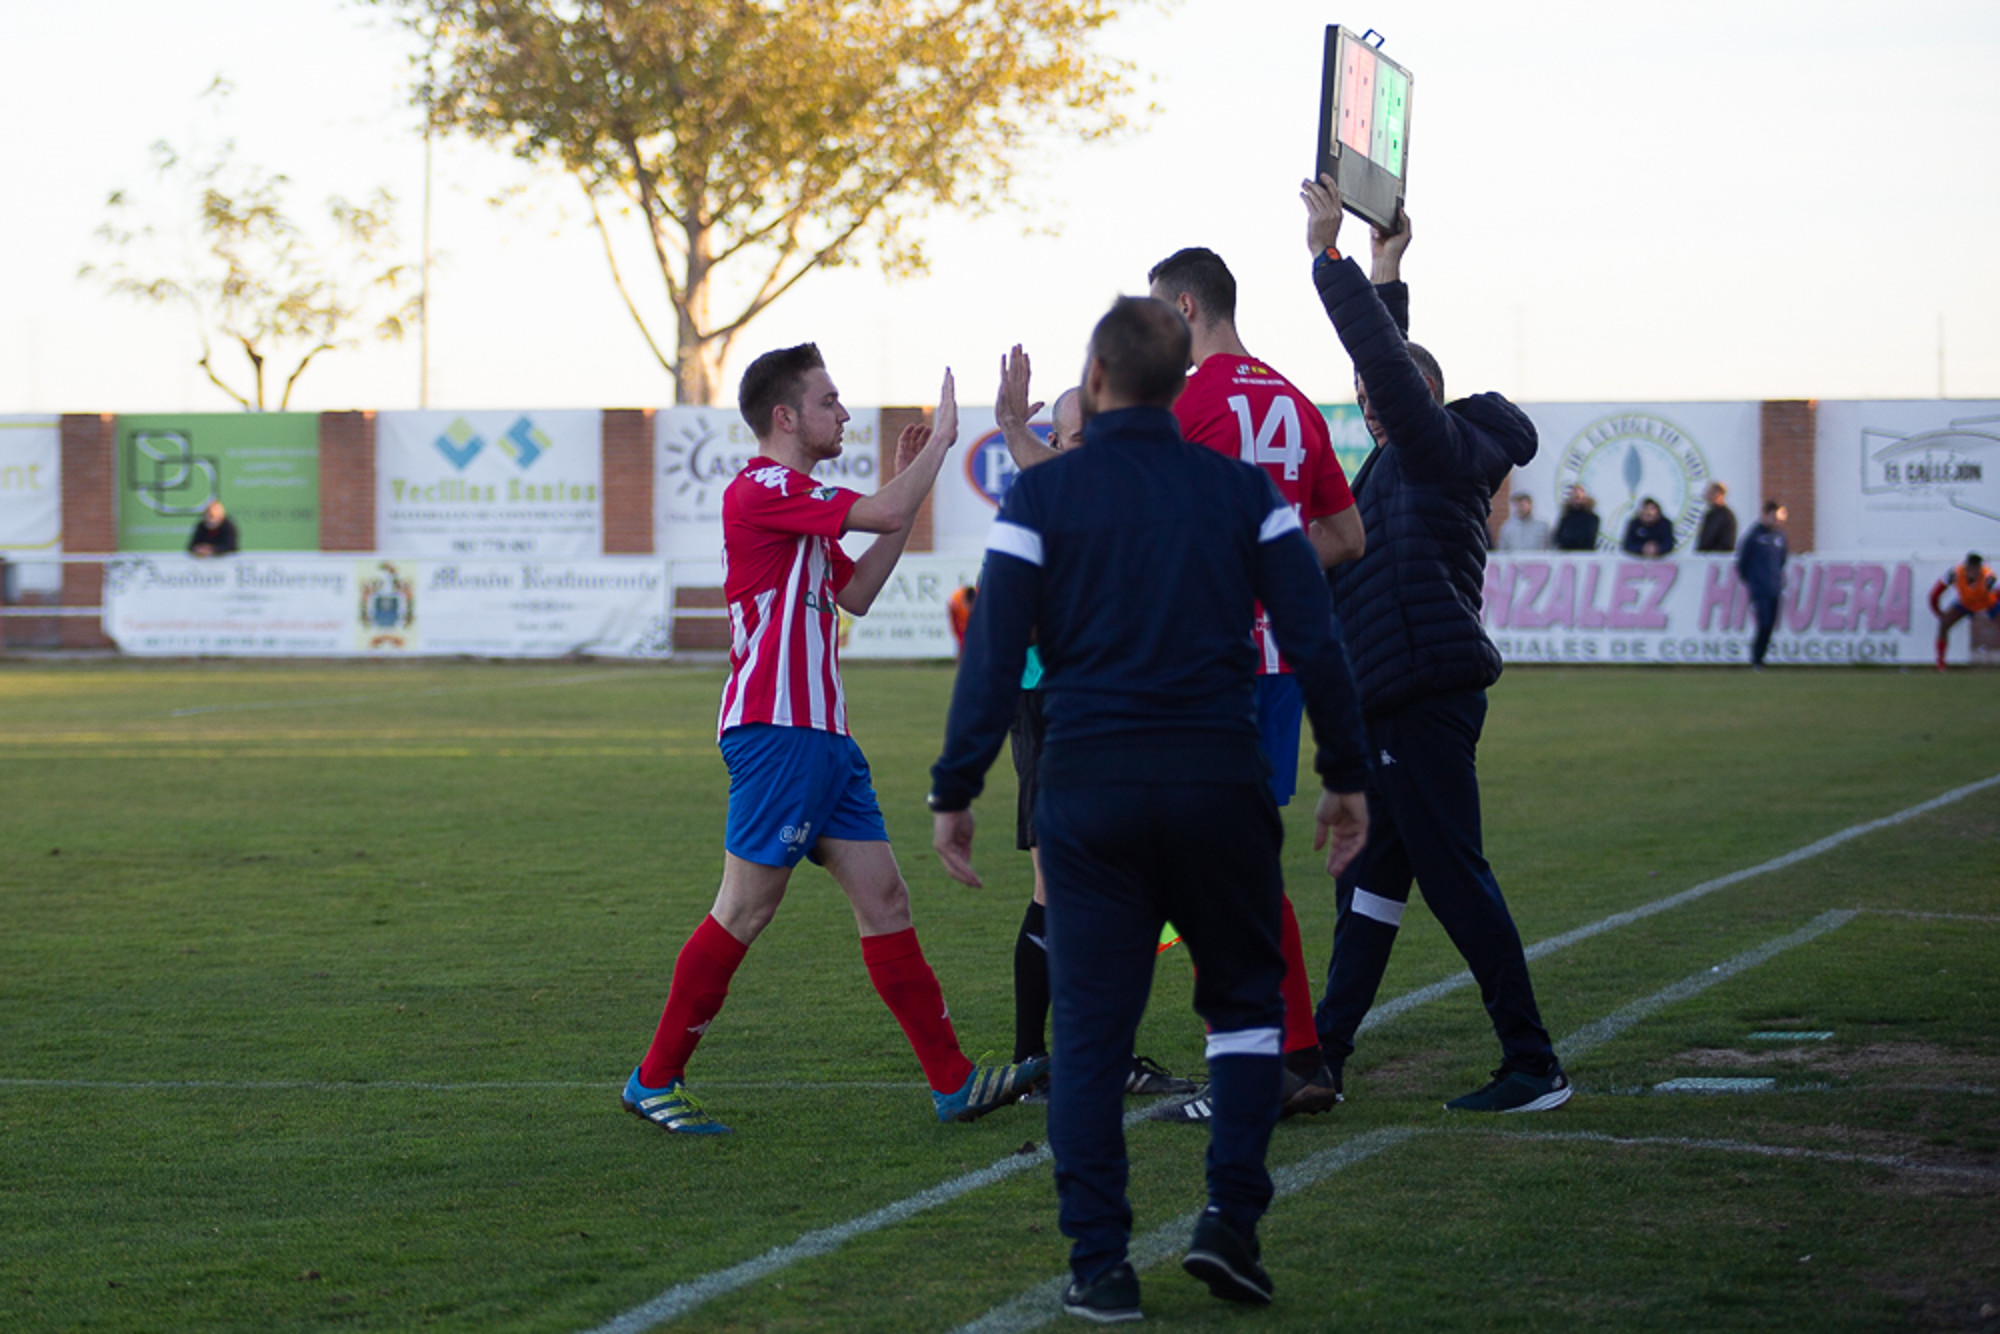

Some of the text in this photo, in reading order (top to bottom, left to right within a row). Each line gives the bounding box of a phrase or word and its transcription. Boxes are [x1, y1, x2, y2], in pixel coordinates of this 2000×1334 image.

[1227, 394, 1306, 481] 14
[0, 463, 42, 491] nt
[508, 478, 597, 502] Santos
[877, 573, 940, 604] AR
[1481, 562, 1911, 632] NZALEZ HIUERA
[1497, 638, 1598, 658] RIALES
[1611, 639, 1647, 658] DE
